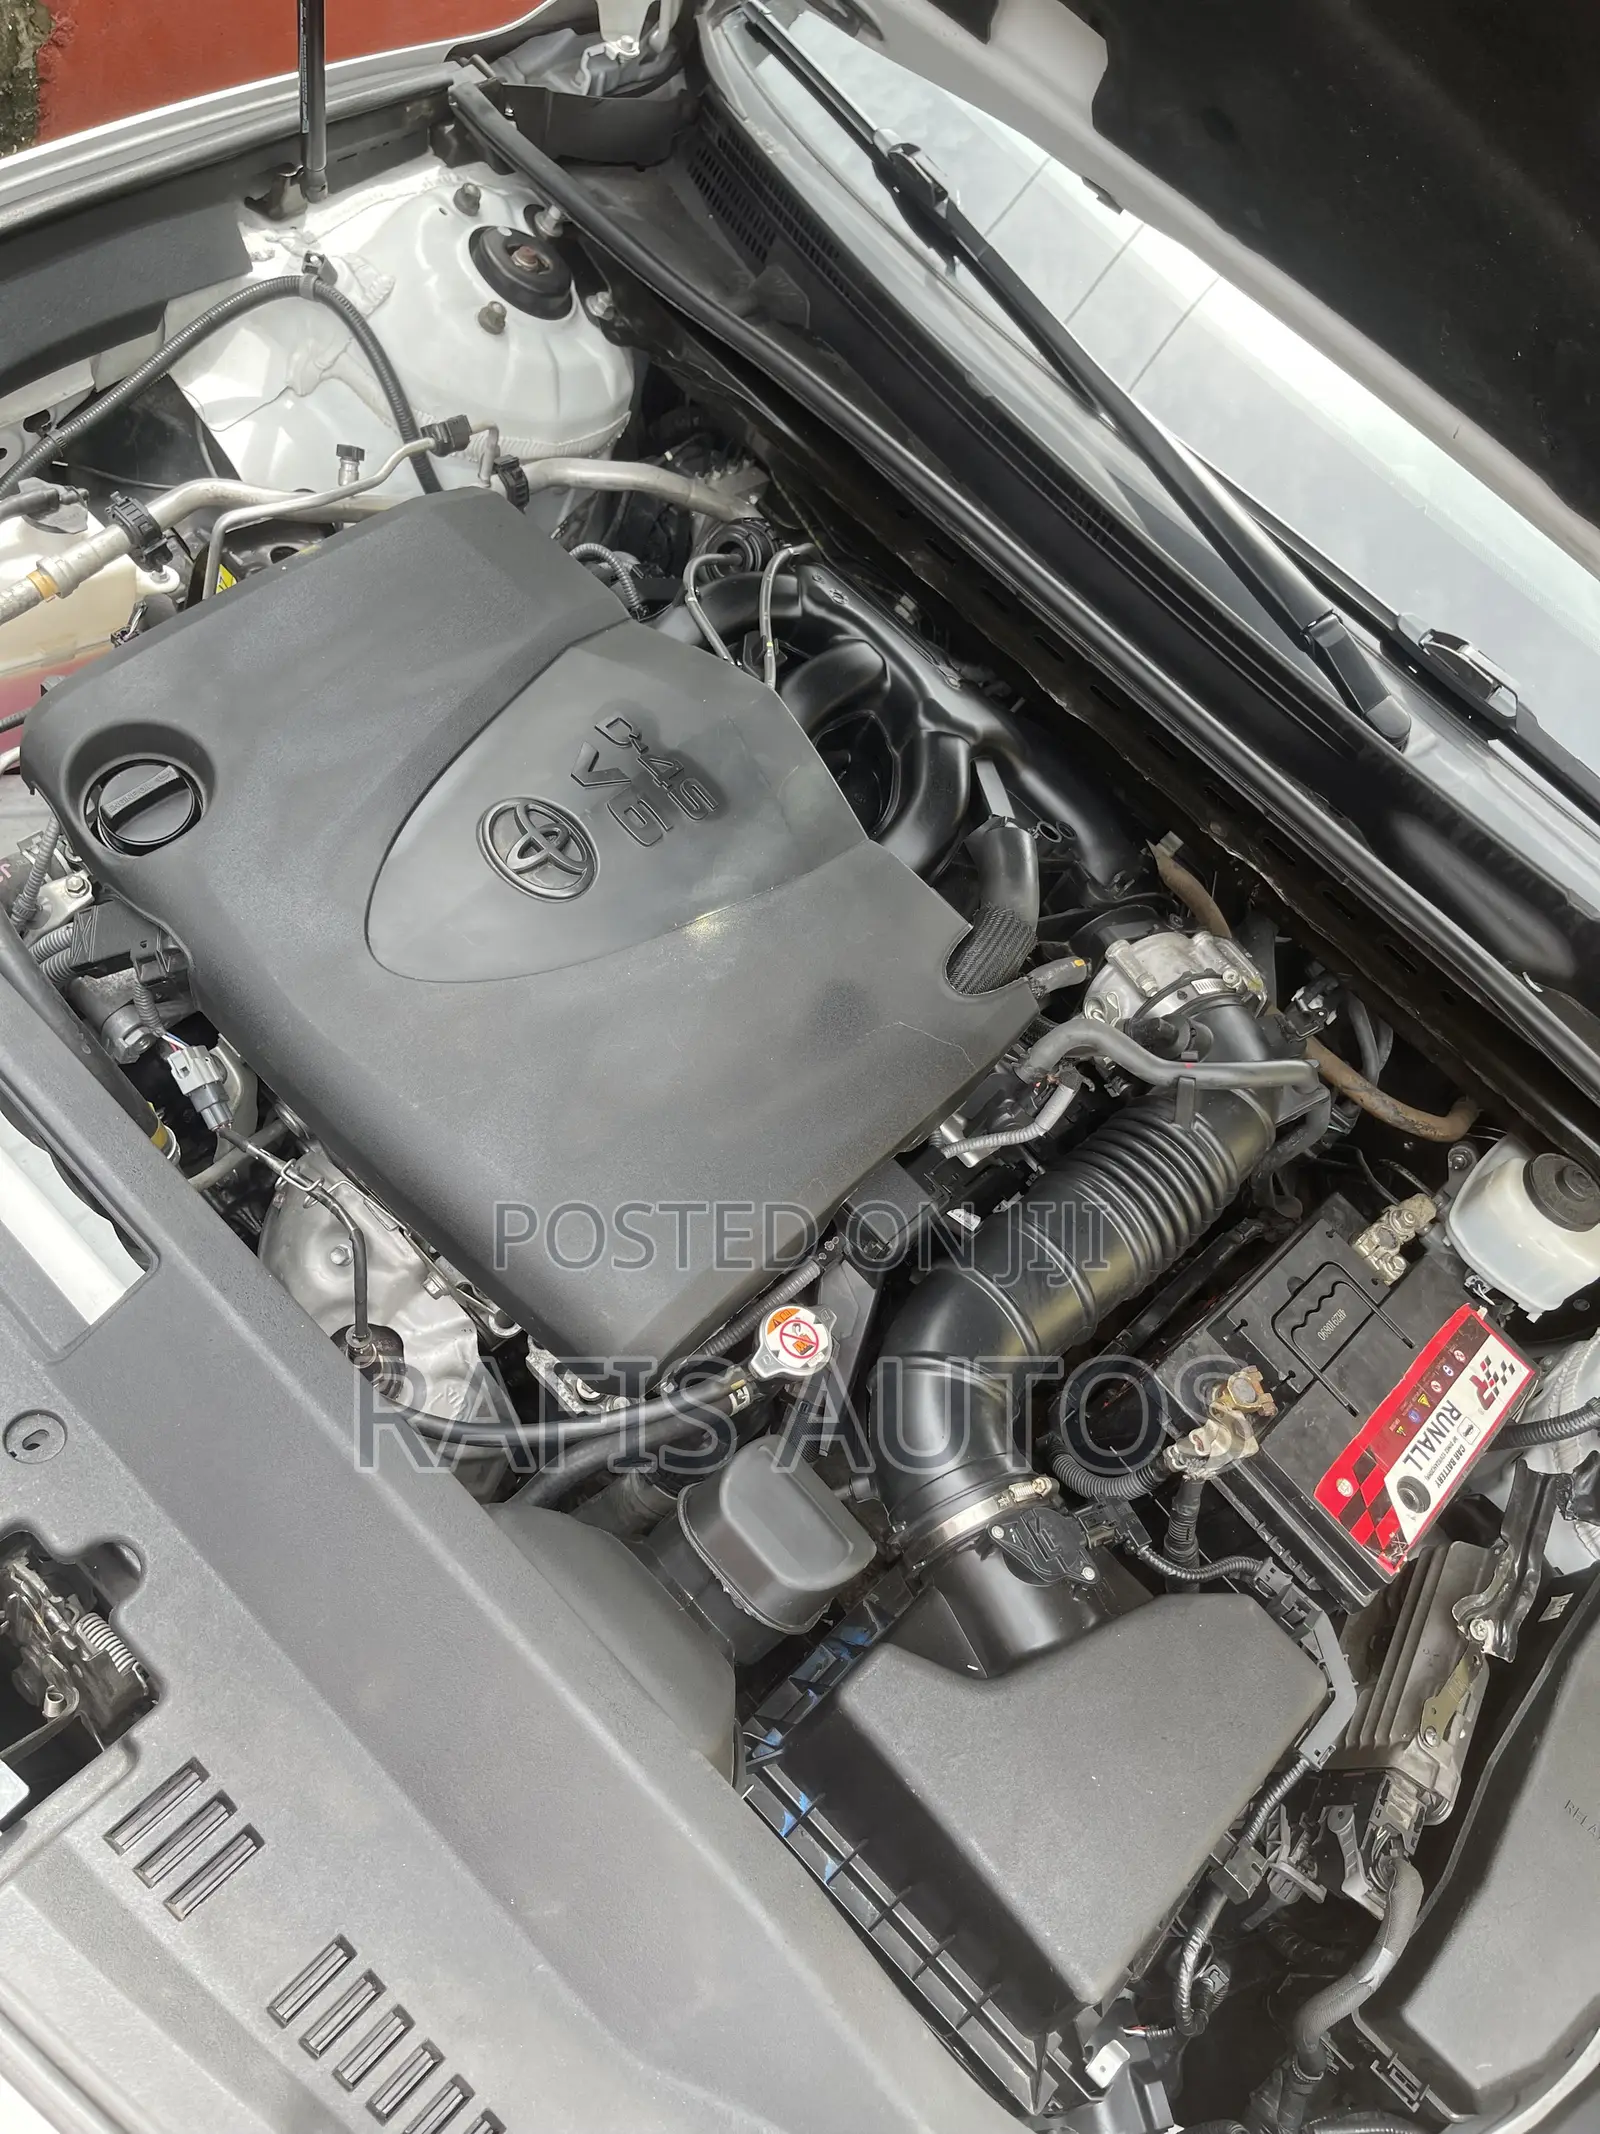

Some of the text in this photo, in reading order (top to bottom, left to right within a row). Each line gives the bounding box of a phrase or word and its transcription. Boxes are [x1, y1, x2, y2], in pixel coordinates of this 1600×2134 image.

[570, 741, 673, 847] V6
[593, 711, 719, 823] D-4S
[108, 782, 153, 813] ENGINE OIL
[1403, 1399, 1462, 1471] RUNALL
[1435, 1444, 1466, 1488] CAR BATTERY
[1563, 1799, 1600, 1840] RELA
